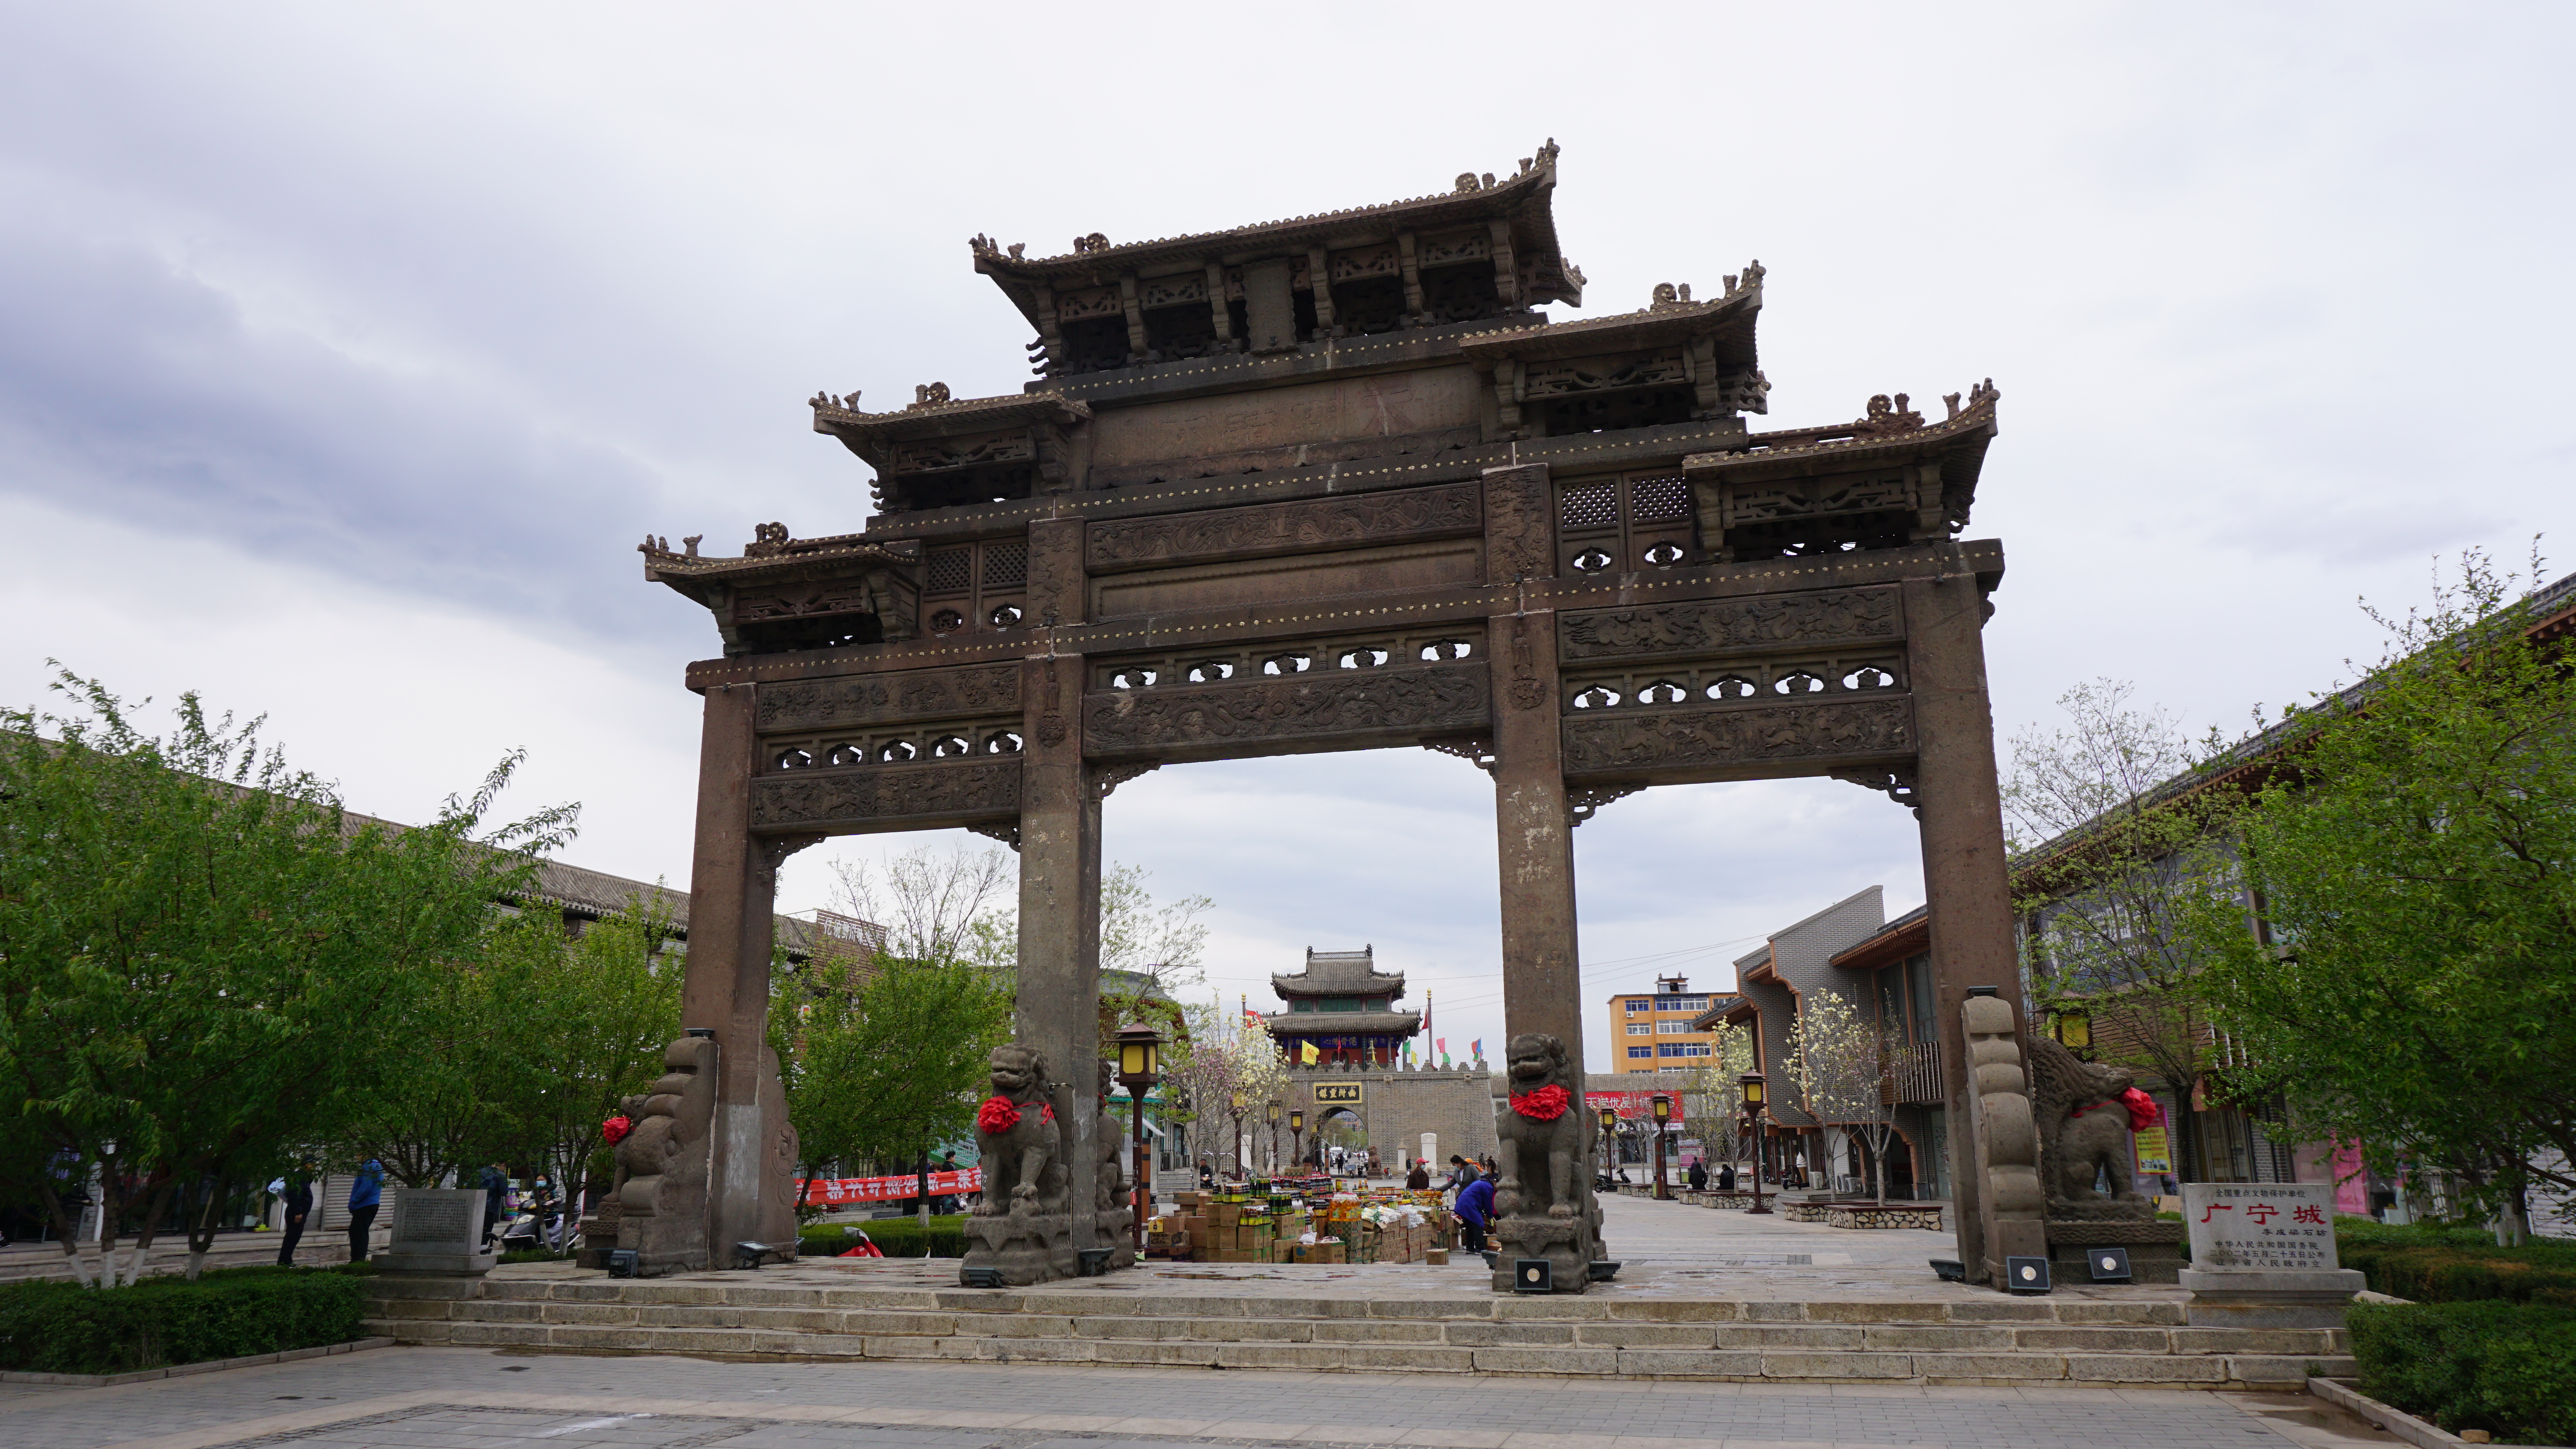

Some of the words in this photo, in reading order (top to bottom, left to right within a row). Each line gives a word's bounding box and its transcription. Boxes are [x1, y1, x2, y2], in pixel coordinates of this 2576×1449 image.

[2215, 1189, 2306, 1198] 全国重点文物保护单位
[2200, 1203, 2327, 1225] 广宁城
[2261, 1228, 2327, 1237] 李成梁石坊
[2215, 1240, 2319, 1250] 中华人民共和国国务院
[2215, 1258, 2321, 1268] 辽宁省人民政府立
